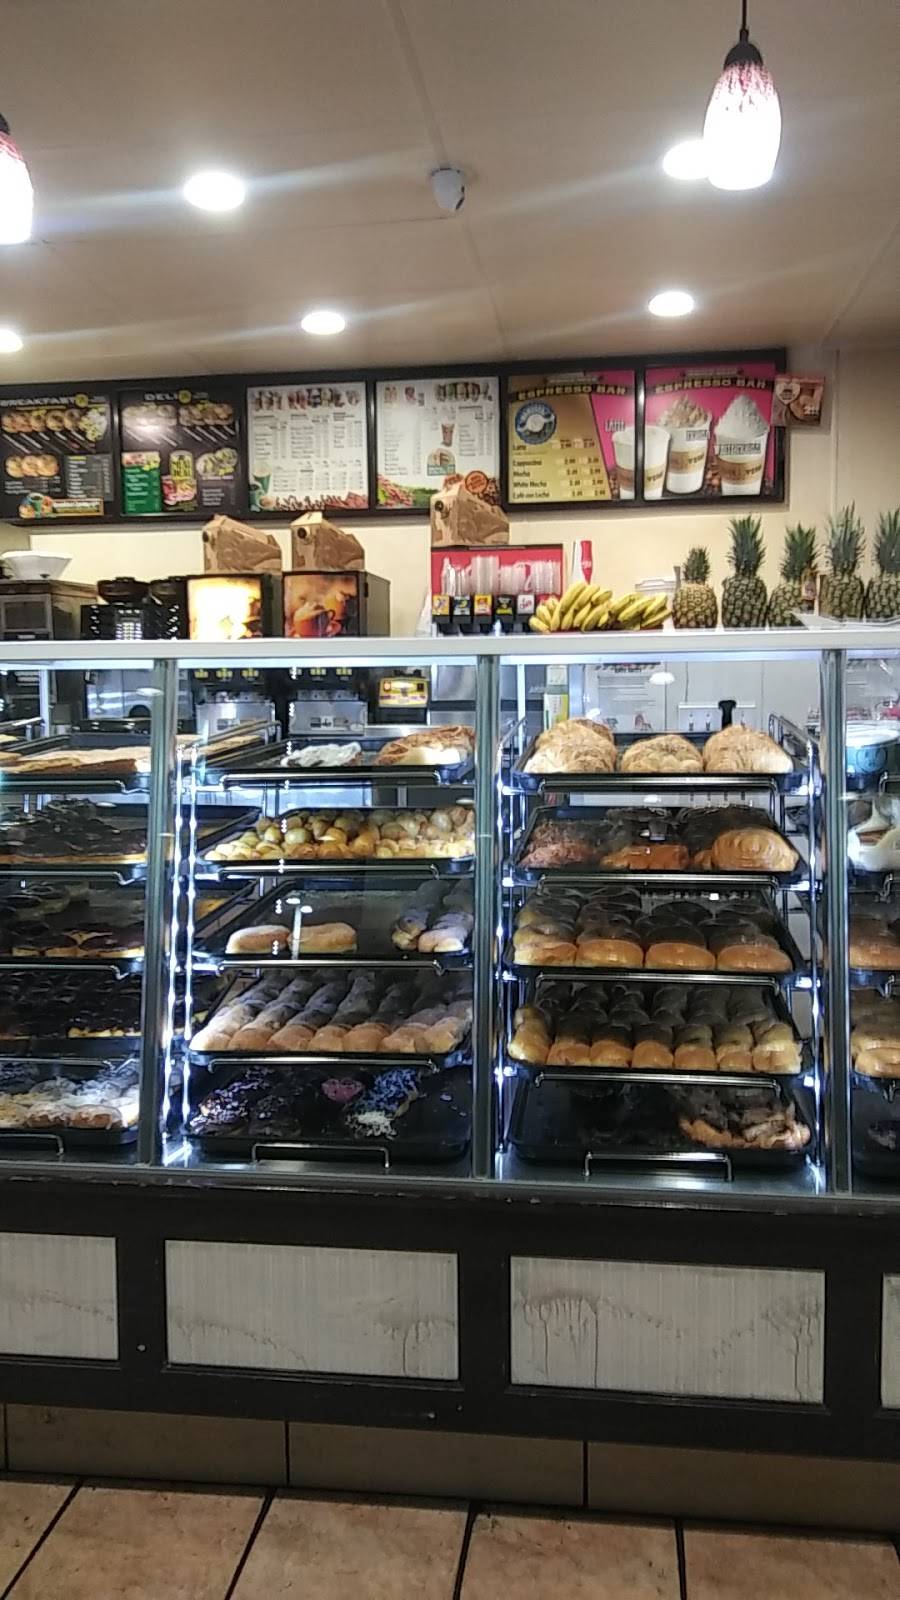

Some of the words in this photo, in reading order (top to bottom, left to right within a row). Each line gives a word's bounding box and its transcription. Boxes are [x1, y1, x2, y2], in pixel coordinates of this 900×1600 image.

[517, 385, 592, 400] ESPRESSO
[597, 385, 626, 396] BAR
[655, 379, 731, 394] ESPRESSO
[736, 379, 766, 389] BAR
[144, 392, 178, 401] DELI
